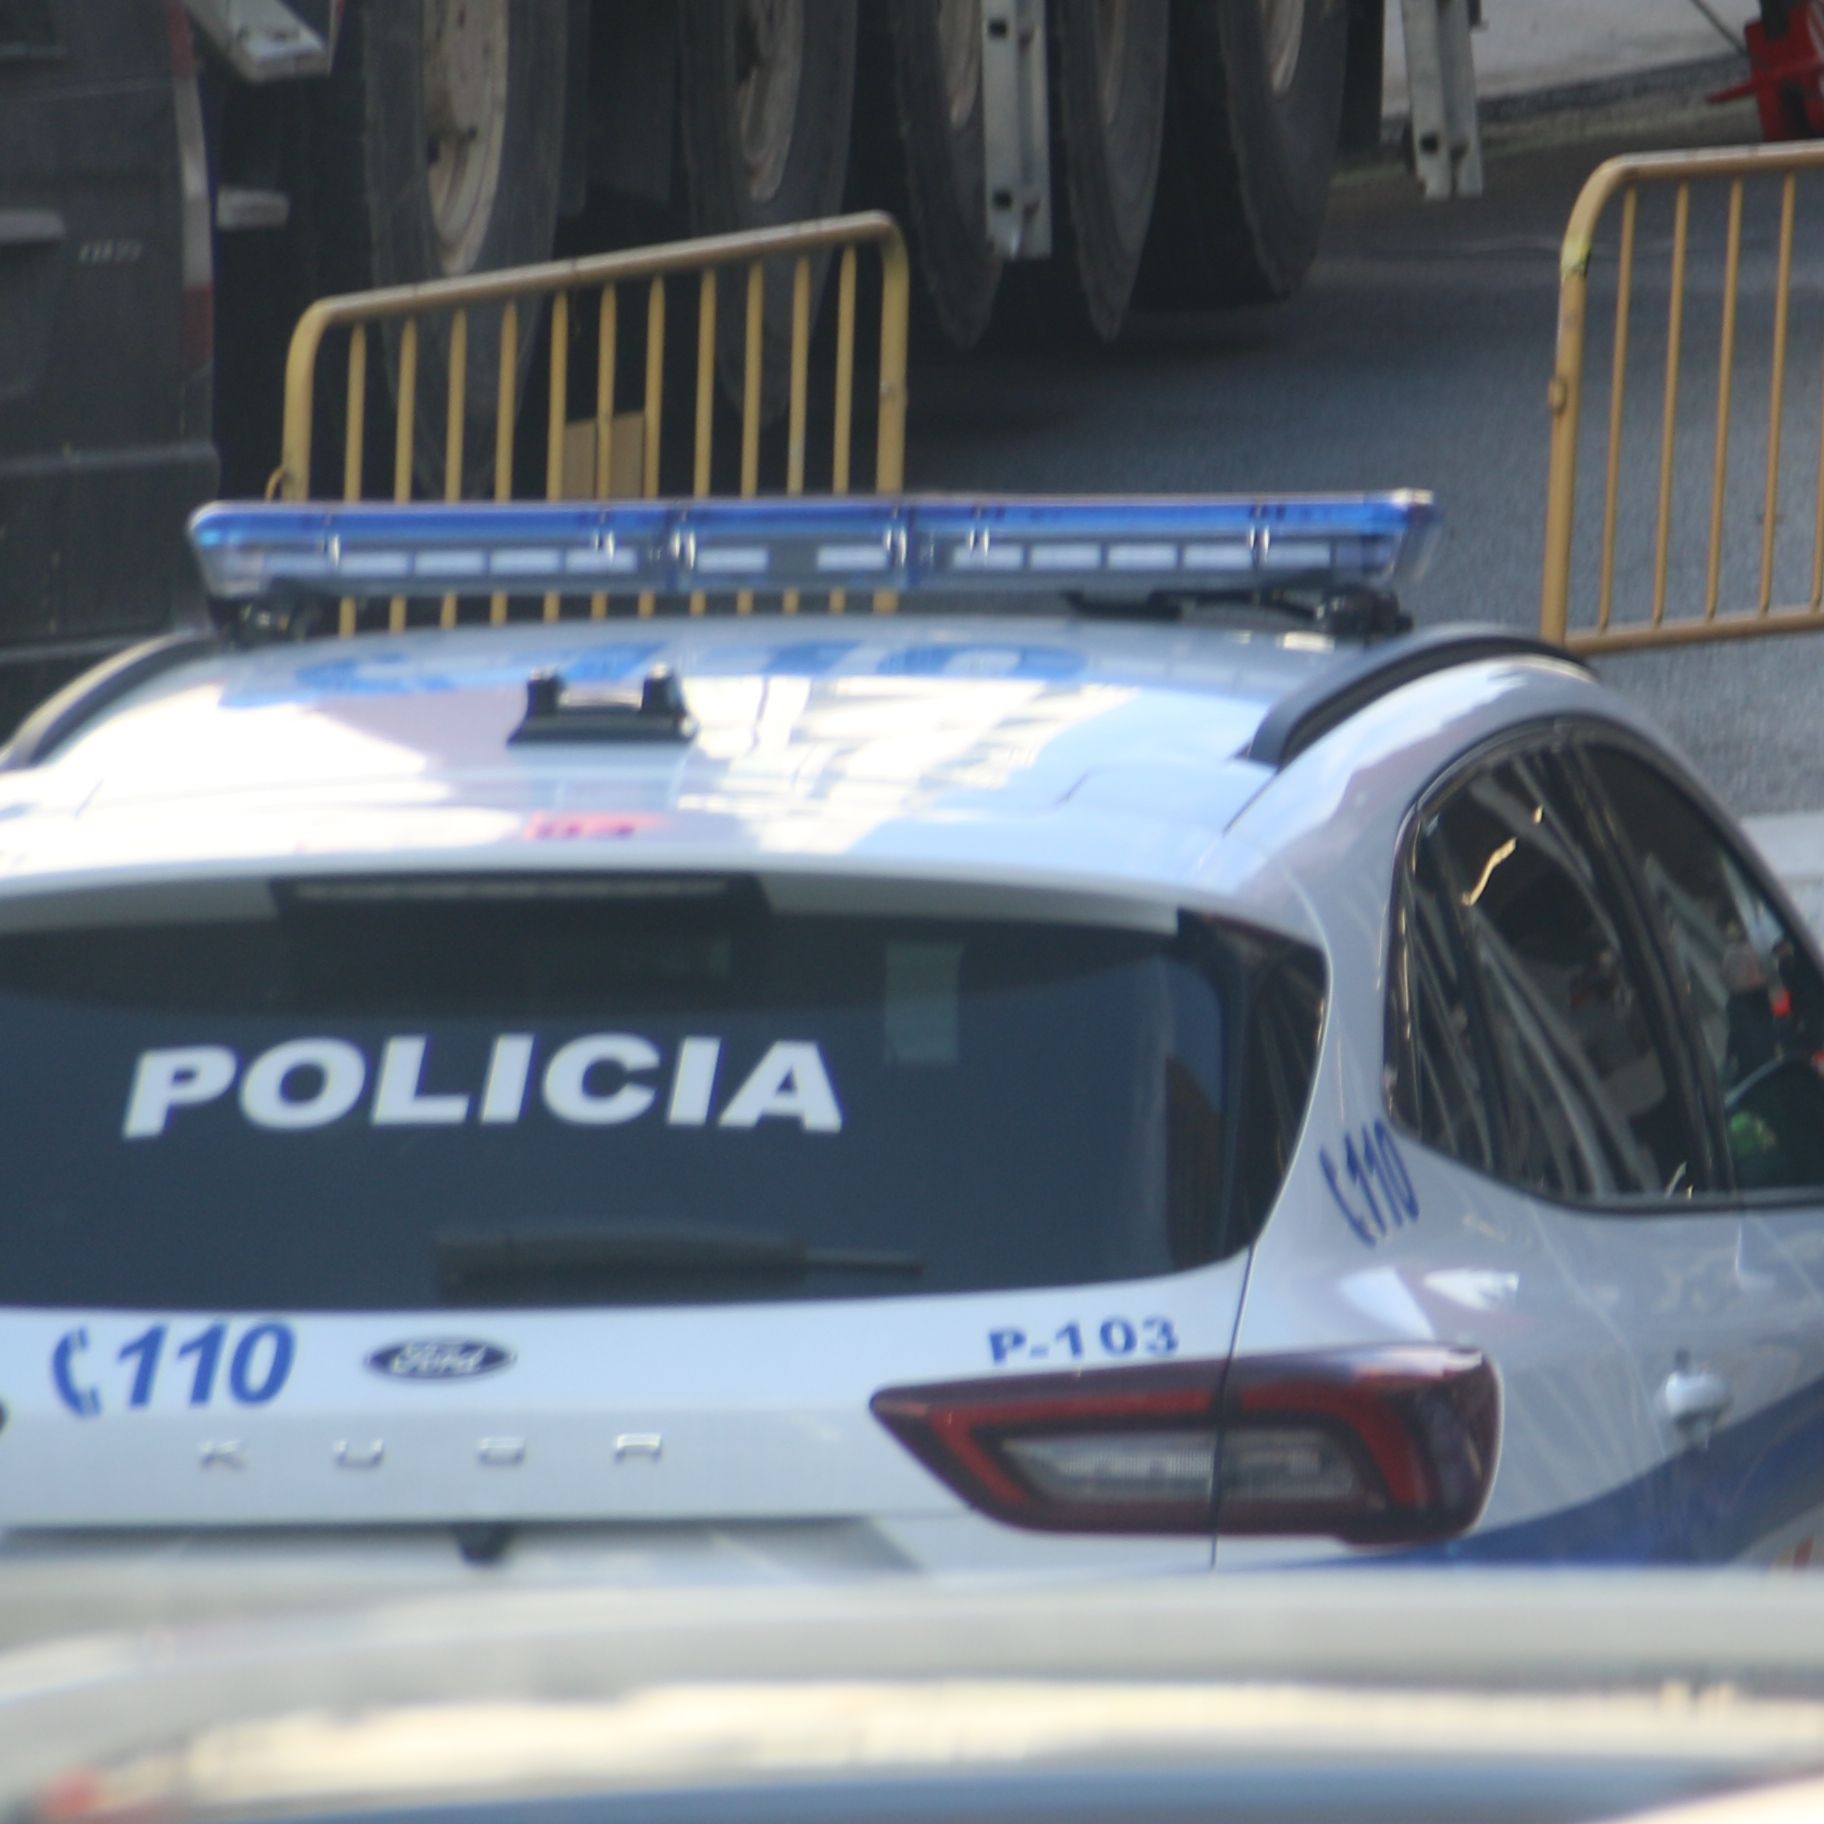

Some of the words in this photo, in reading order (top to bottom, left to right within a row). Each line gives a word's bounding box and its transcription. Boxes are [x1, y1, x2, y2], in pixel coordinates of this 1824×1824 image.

[123, 1033, 842, 1141] POLICIA
[1343, 1118, 1420, 1237] 110
[116, 1321, 297, 1408] 110
[988, 1314, 1180, 1366] P-103
